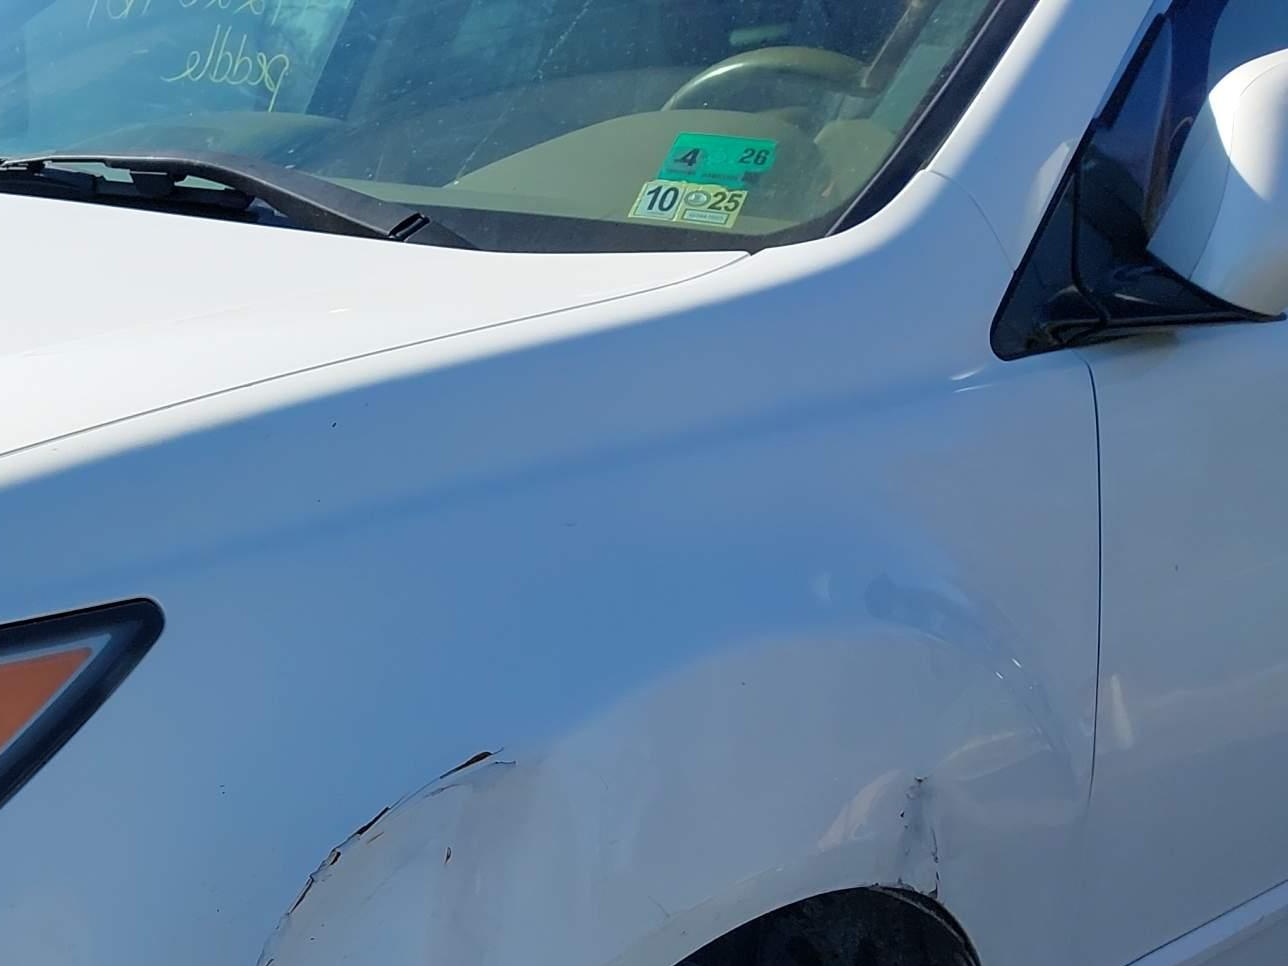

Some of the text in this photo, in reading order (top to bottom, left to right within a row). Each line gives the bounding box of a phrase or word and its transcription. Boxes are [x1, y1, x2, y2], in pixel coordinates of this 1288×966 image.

[674, 148, 770, 166] 4 26
[646, 185, 742, 212] 10 25
